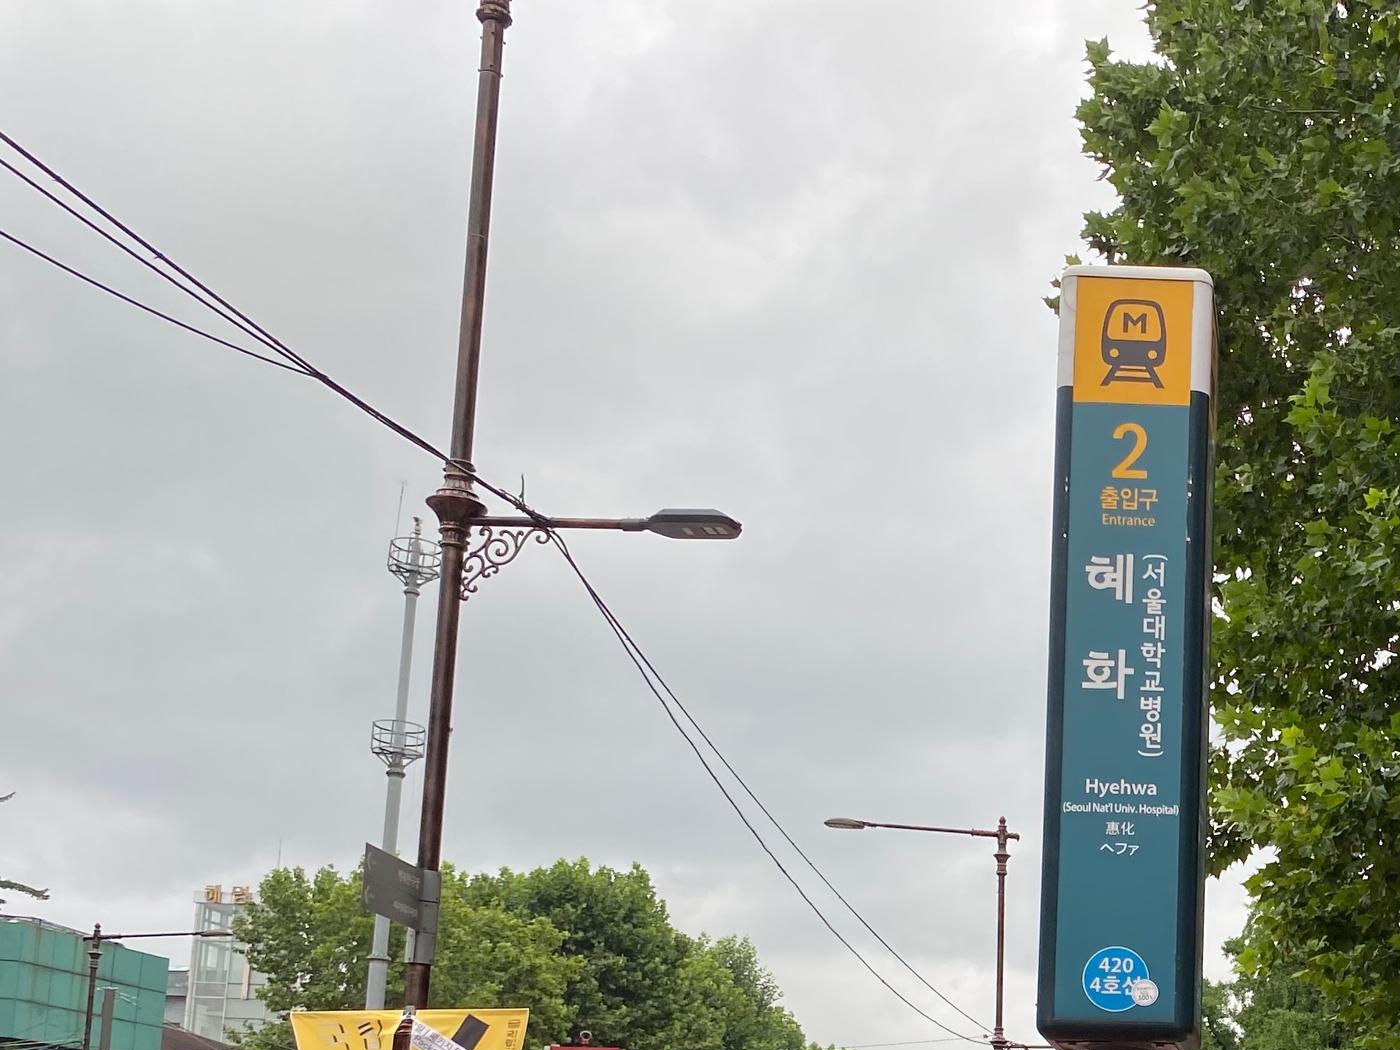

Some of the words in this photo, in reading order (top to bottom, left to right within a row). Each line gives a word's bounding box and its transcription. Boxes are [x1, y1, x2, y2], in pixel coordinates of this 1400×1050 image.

[1111, 423, 1147, 479] 2
[1100, 487, 1159, 511] 출입구
[1101, 513, 1156, 527] Entrance
[1137, 554, 1169, 757] (서울대학교병원)
[1085, 778, 1157, 798] Hyehwa
[1063, 801, 1091, 813] (Seoul
[1093, 802, 1113, 813] Nat'l
[1114, 803, 1138, 814] Univ.
[1139, 803, 1179, 816] Hospital)
[1098, 957, 1134, 973] 420
